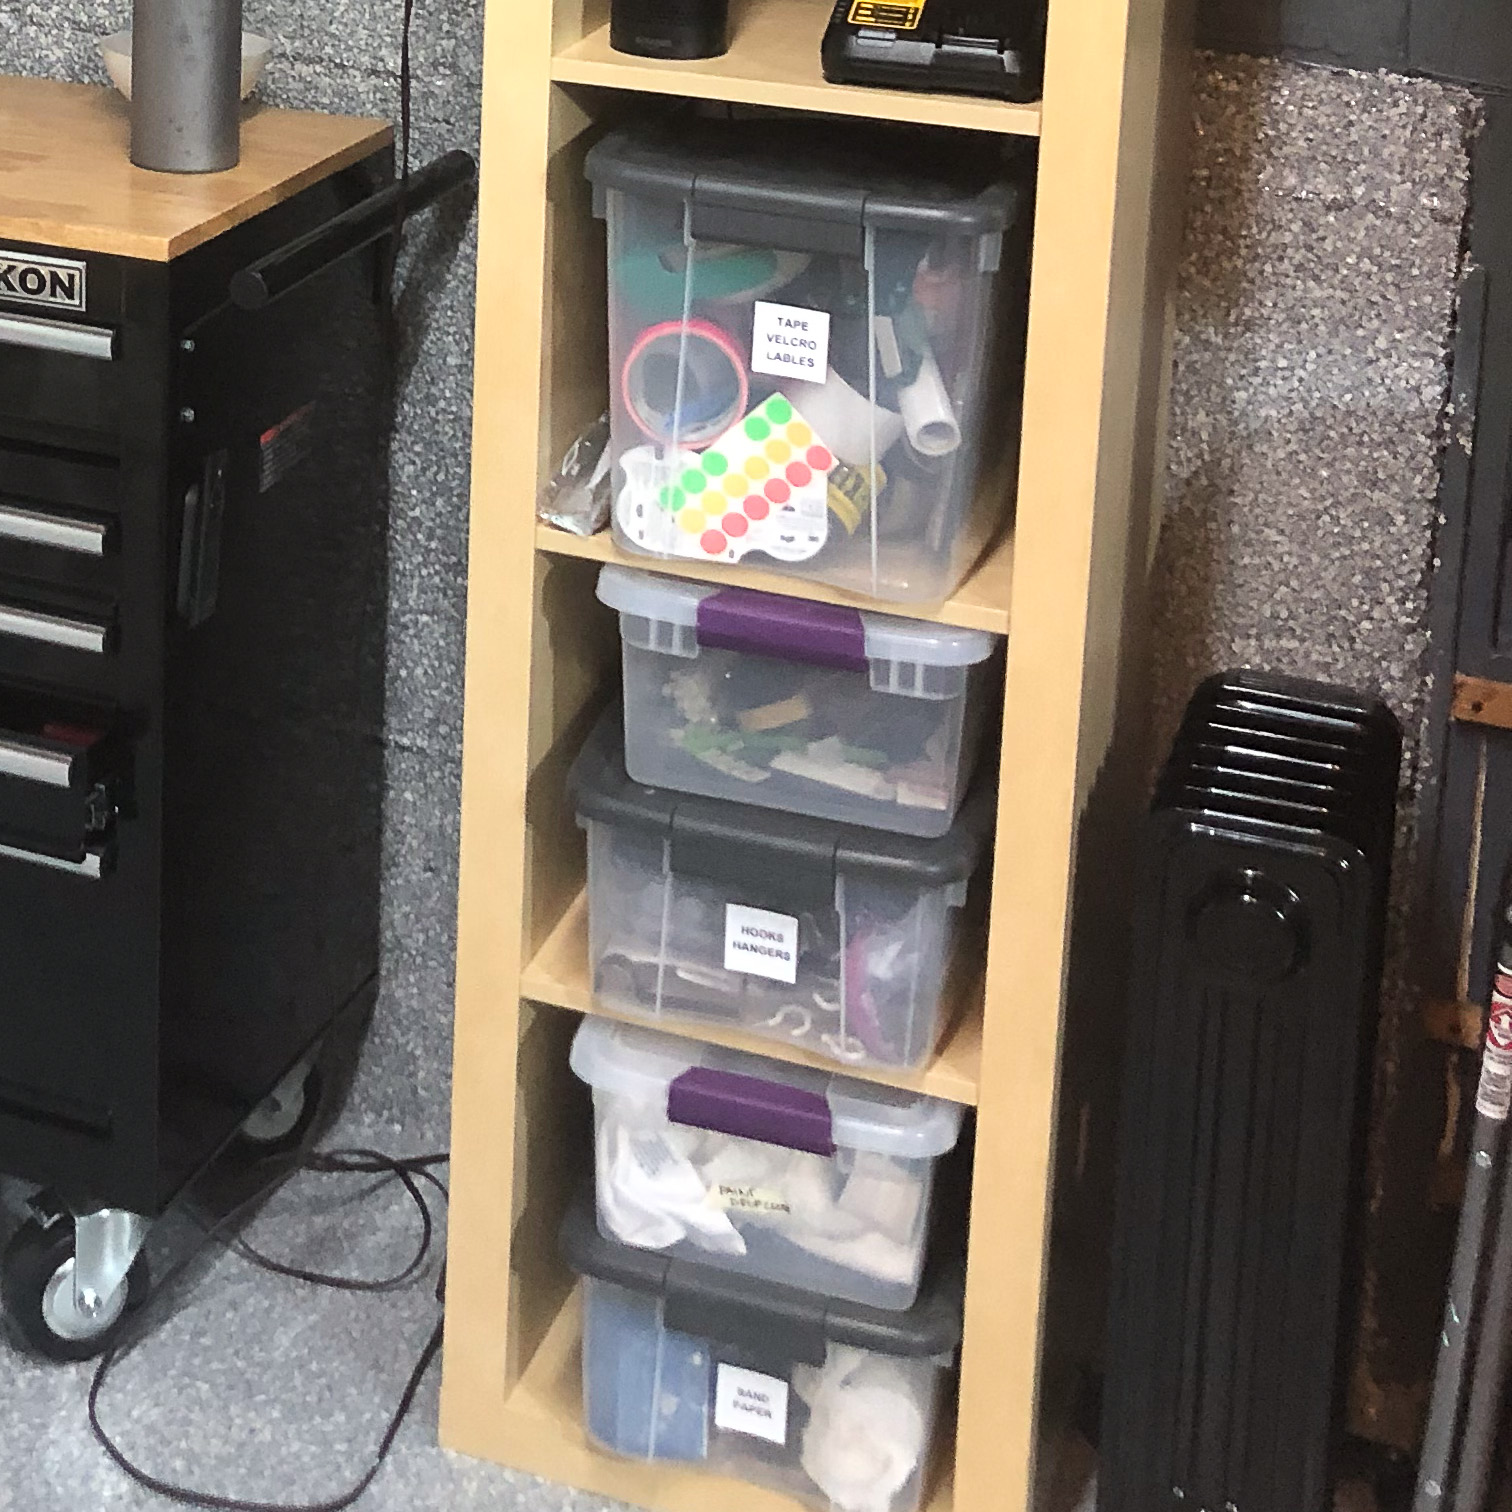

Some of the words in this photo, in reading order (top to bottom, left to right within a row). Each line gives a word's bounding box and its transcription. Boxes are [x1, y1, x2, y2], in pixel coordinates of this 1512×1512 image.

[777, 317, 809, 332] TAPE
[766, 333, 817, 350] VELCRO
[766, 351, 815, 368] LABLES
[741, 926, 784, 943] HOOKS
[732, 941, 791, 962] HANGERS
